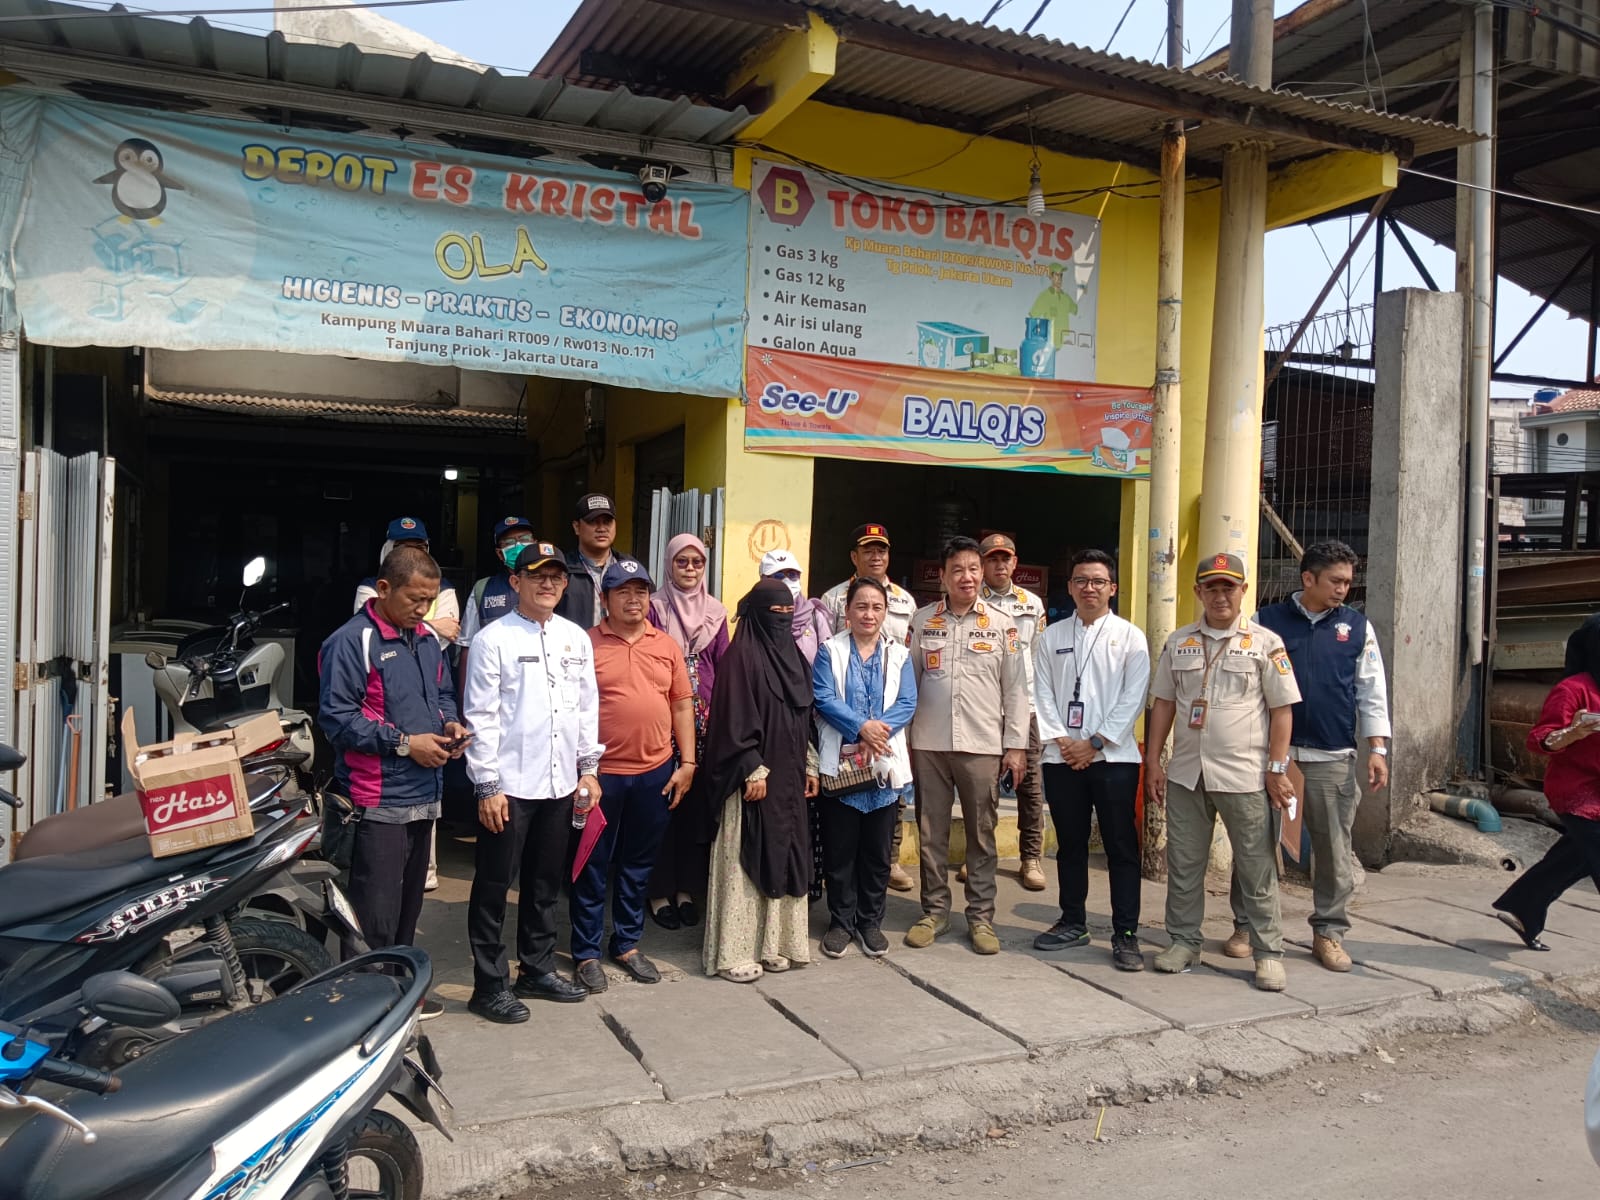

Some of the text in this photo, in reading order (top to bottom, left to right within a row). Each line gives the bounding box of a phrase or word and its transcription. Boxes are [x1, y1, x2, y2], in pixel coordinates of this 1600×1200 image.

[242, 144, 701, 238] DEPOT ES KRISTAL
[826, 189, 1074, 261] TOKO BALQIS
[434, 226, 548, 281] OLA
[776, 244, 839, 269] Gas 3 kg
[863, 238, 901, 257] Muara
[775, 267, 846, 293] Gas 12 kg
[281, 275, 402, 309] HIGIENIS
[424, 289, 533, 323] PRAKTIS
[559, 304, 679, 342] EKONOMIS
[774, 290, 867, 314] Air Kemasan
[321, 312, 397, 334] Kampung
[401, 319, 451, 336] Muara
[455, 325, 504, 341] Bahari
[508, 330, 550, 346] RT009
[563, 337, 608, 353] Rw013
[611, 342, 656, 360] No.171
[774, 313, 863, 339] Air isi ulang
[385, 336, 449, 357] Tanjung
[452, 343, 491, 358] Priok
[502, 348, 556, 365] Jakarta
[560, 355, 600, 370] Utara
[773, 336, 857, 358] Galon Aqua
[903, 395, 1046, 449] BALQIS
[152, 789, 228, 824] Hass
[110, 879, 204, 929] STREET
